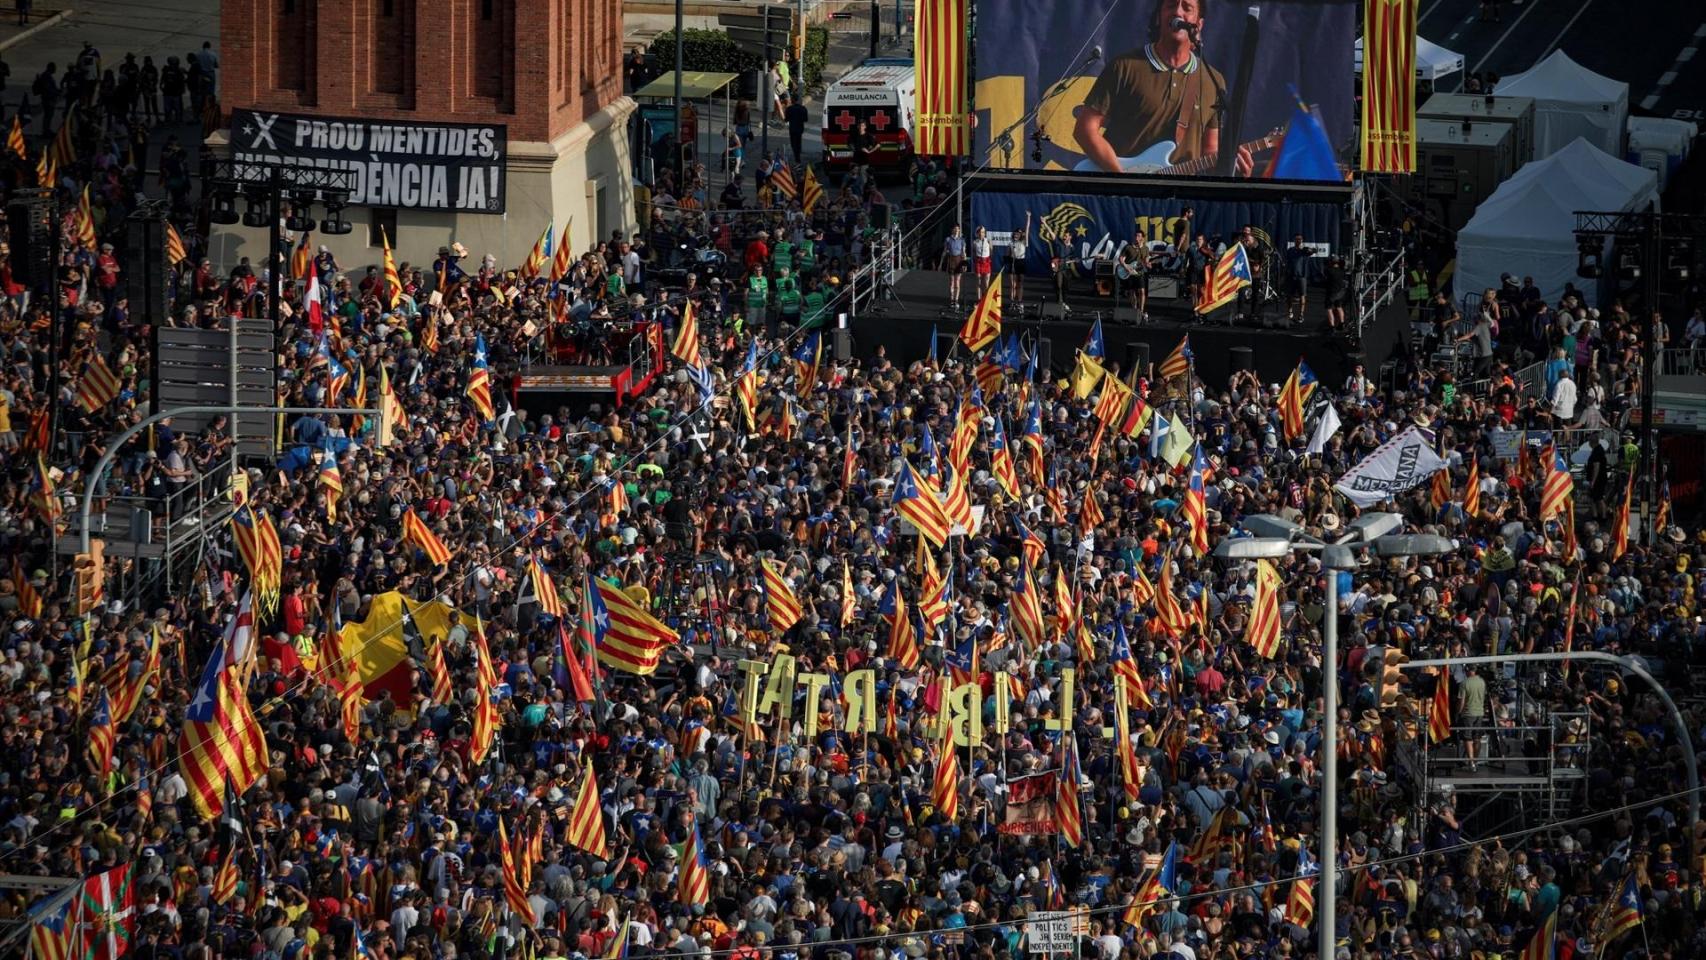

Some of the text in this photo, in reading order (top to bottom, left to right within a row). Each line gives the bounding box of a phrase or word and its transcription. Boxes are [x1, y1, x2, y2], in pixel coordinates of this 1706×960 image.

[295, 119, 365, 151] PROU
[369, 125, 499, 161] MENTIDES,
[455, 165, 500, 210] JA!
